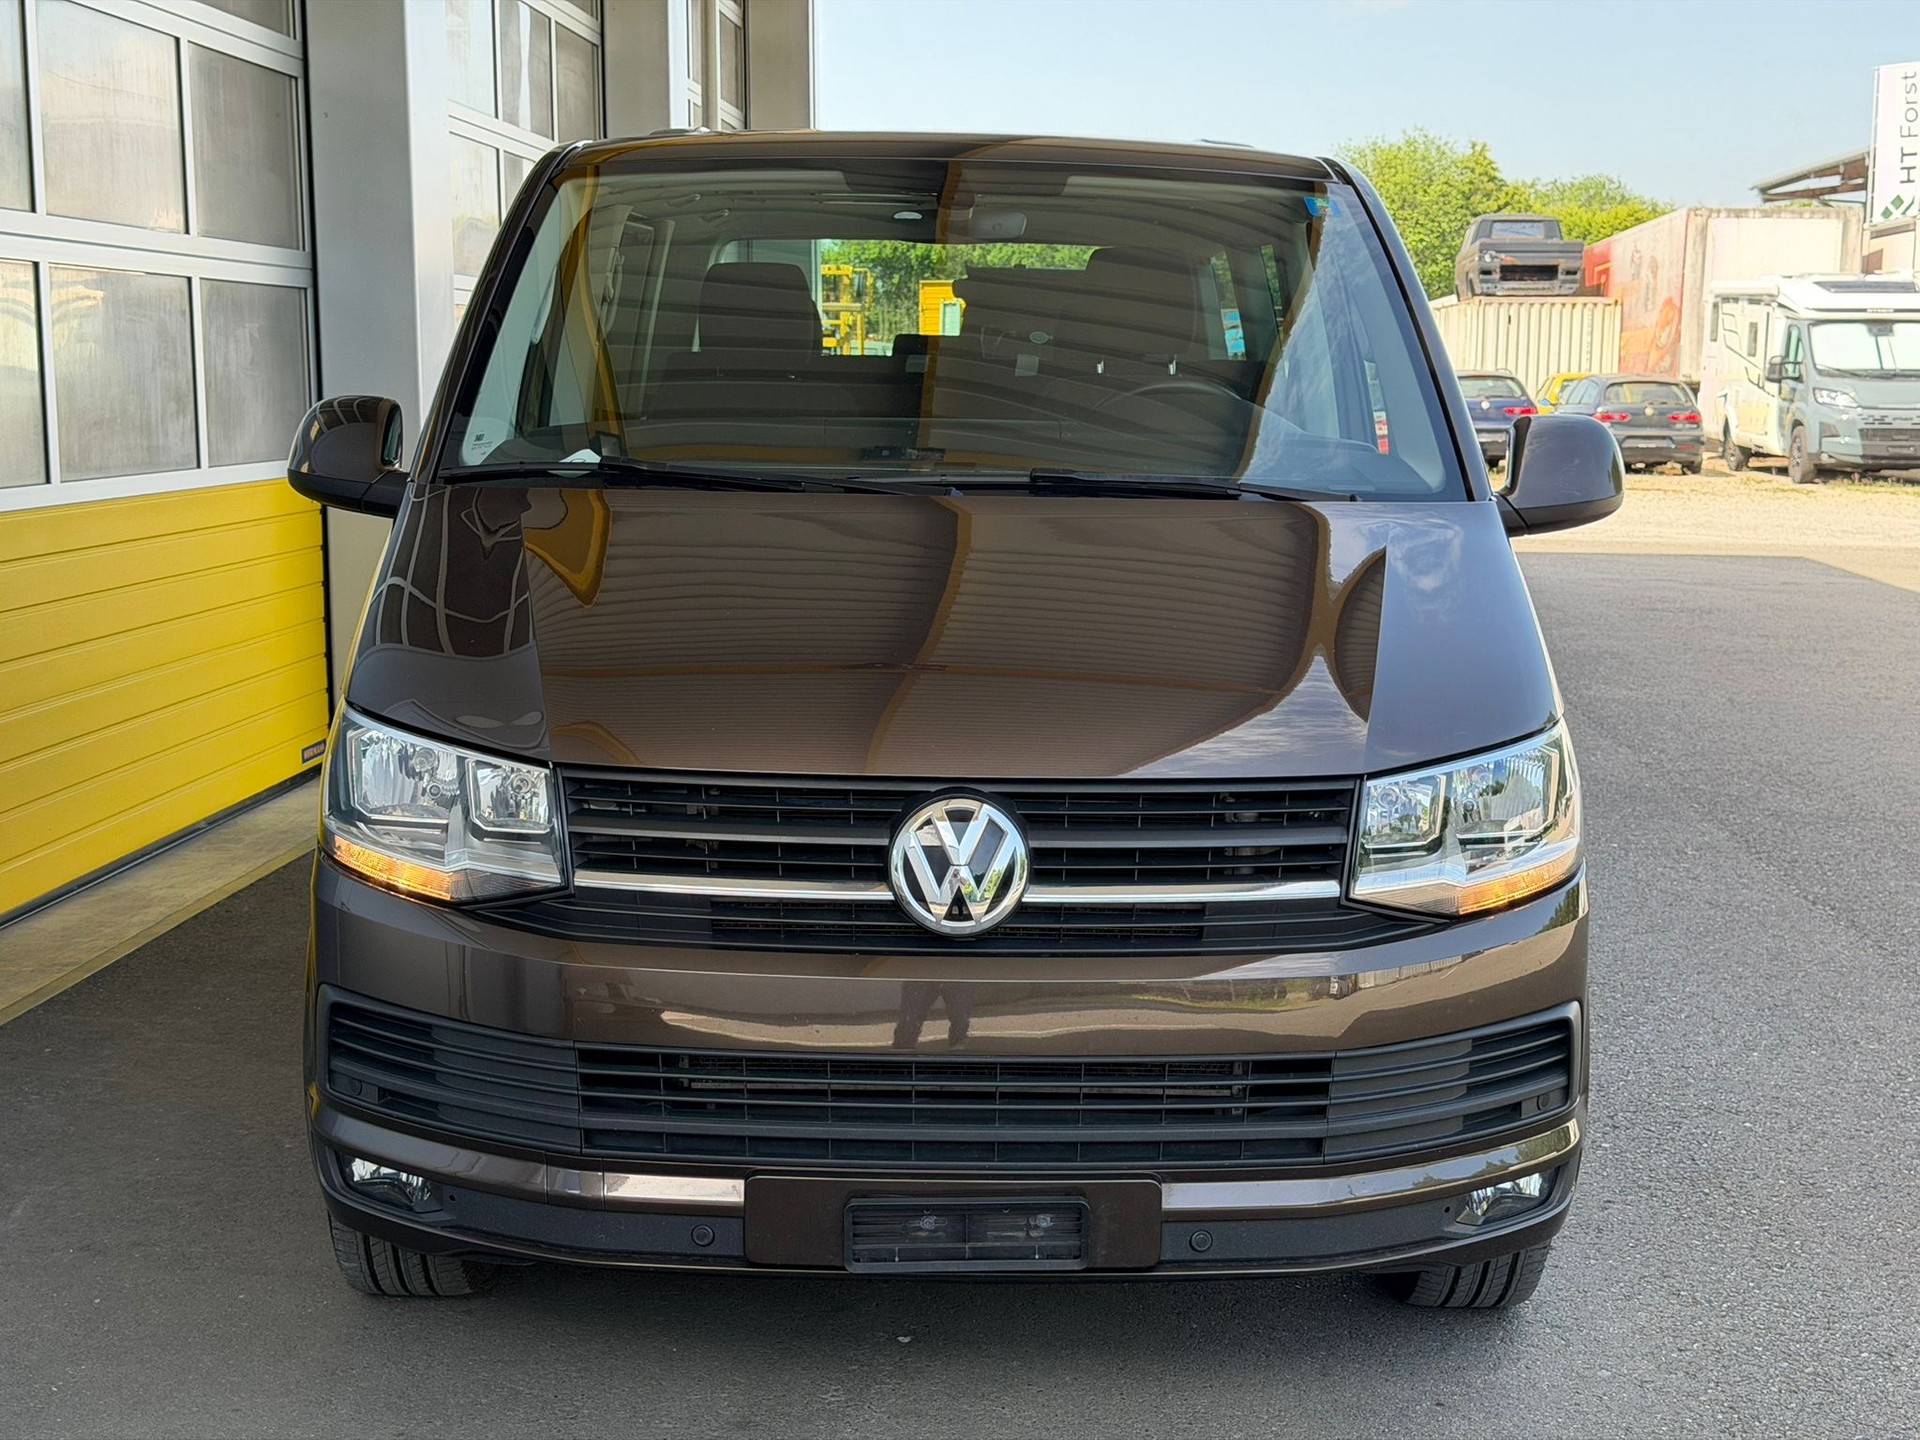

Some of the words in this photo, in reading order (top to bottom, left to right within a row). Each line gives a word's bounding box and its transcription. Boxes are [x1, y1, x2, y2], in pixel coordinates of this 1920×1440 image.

[1900, 71, 1919, 138] Forst
[1899, 146, 1918, 184] HT
[892, 798, 1027, 935] VW
